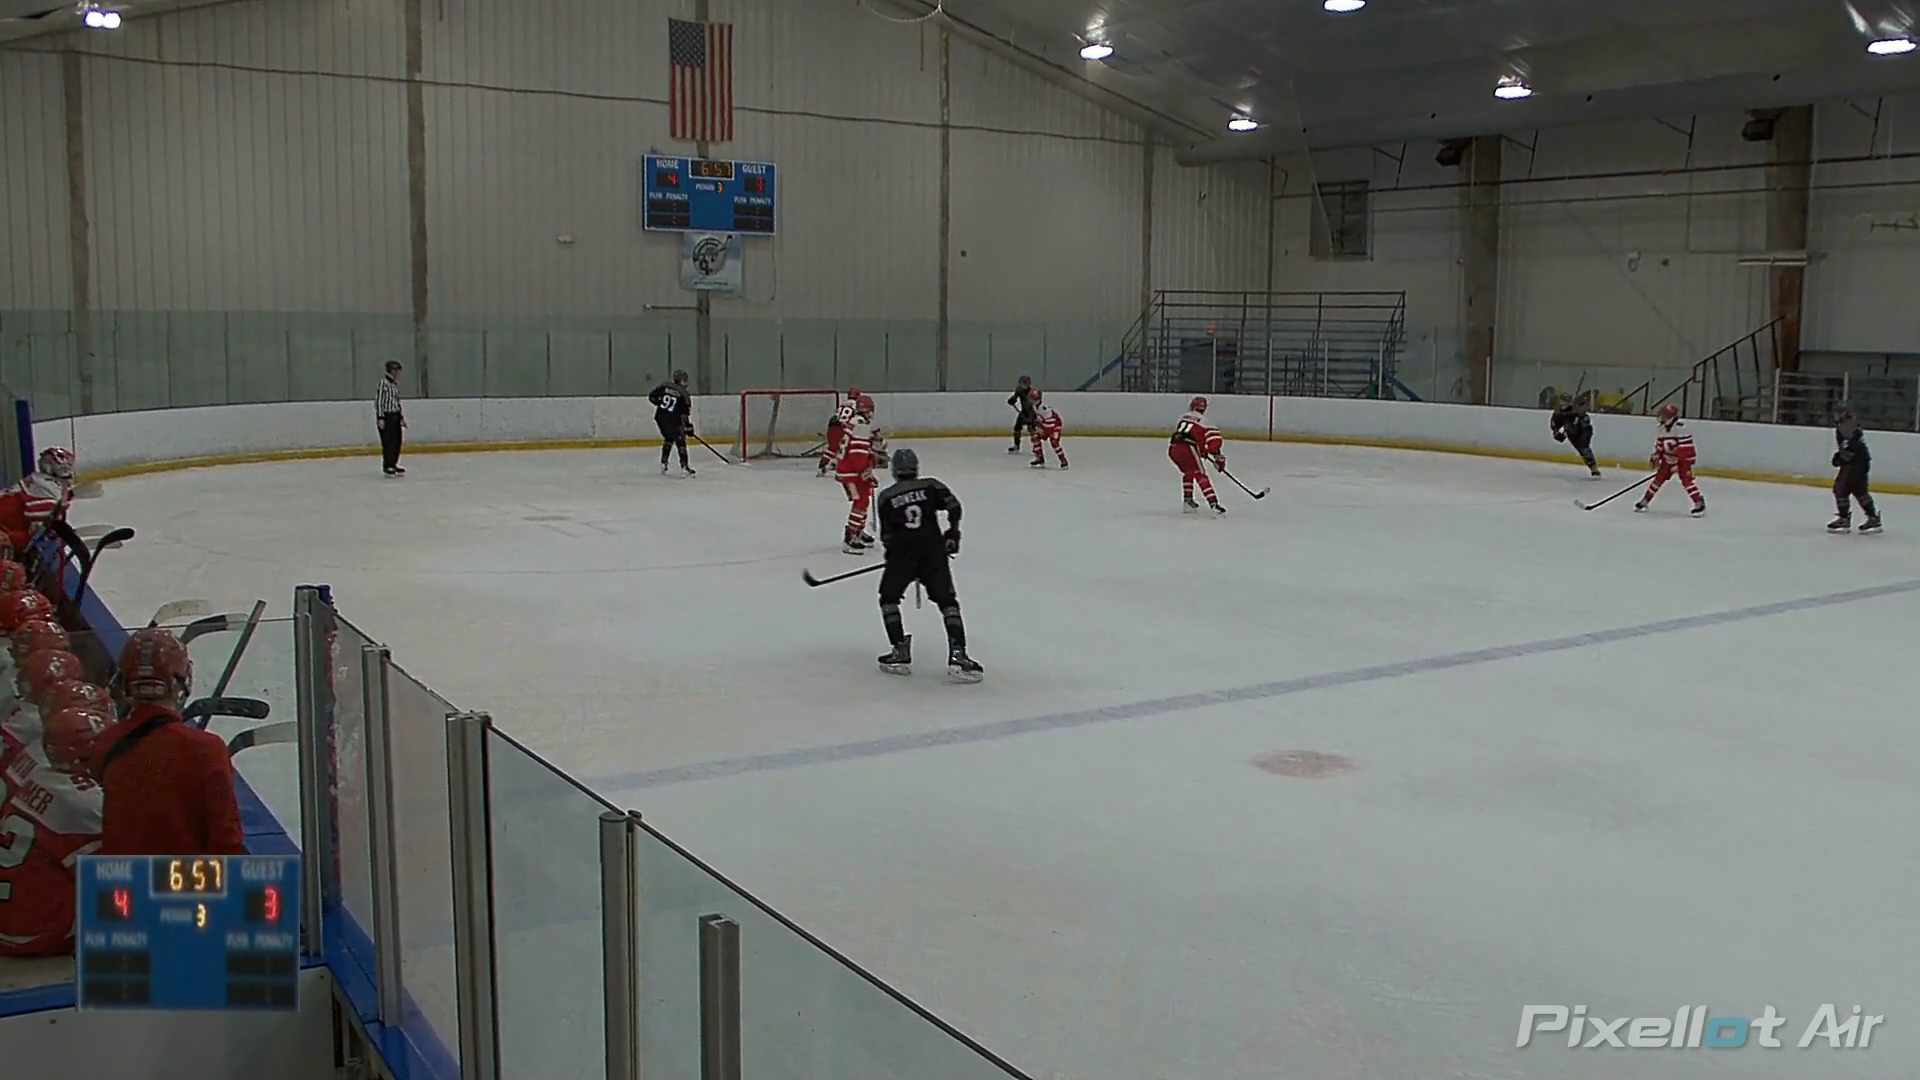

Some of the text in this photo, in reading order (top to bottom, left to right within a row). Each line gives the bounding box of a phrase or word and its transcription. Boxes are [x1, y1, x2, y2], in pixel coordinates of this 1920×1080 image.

[656, 160, 679, 169] HOME
[742, 164, 767, 174] GUEST
[668, 173, 679, 185] 4
[717, 182, 724, 194] 3
[665, 192, 689, 201] PENALTY
[749, 196, 772, 204] PENALTY
[660, 394, 677, 412] 97
[904, 504, 922, 529] 9
